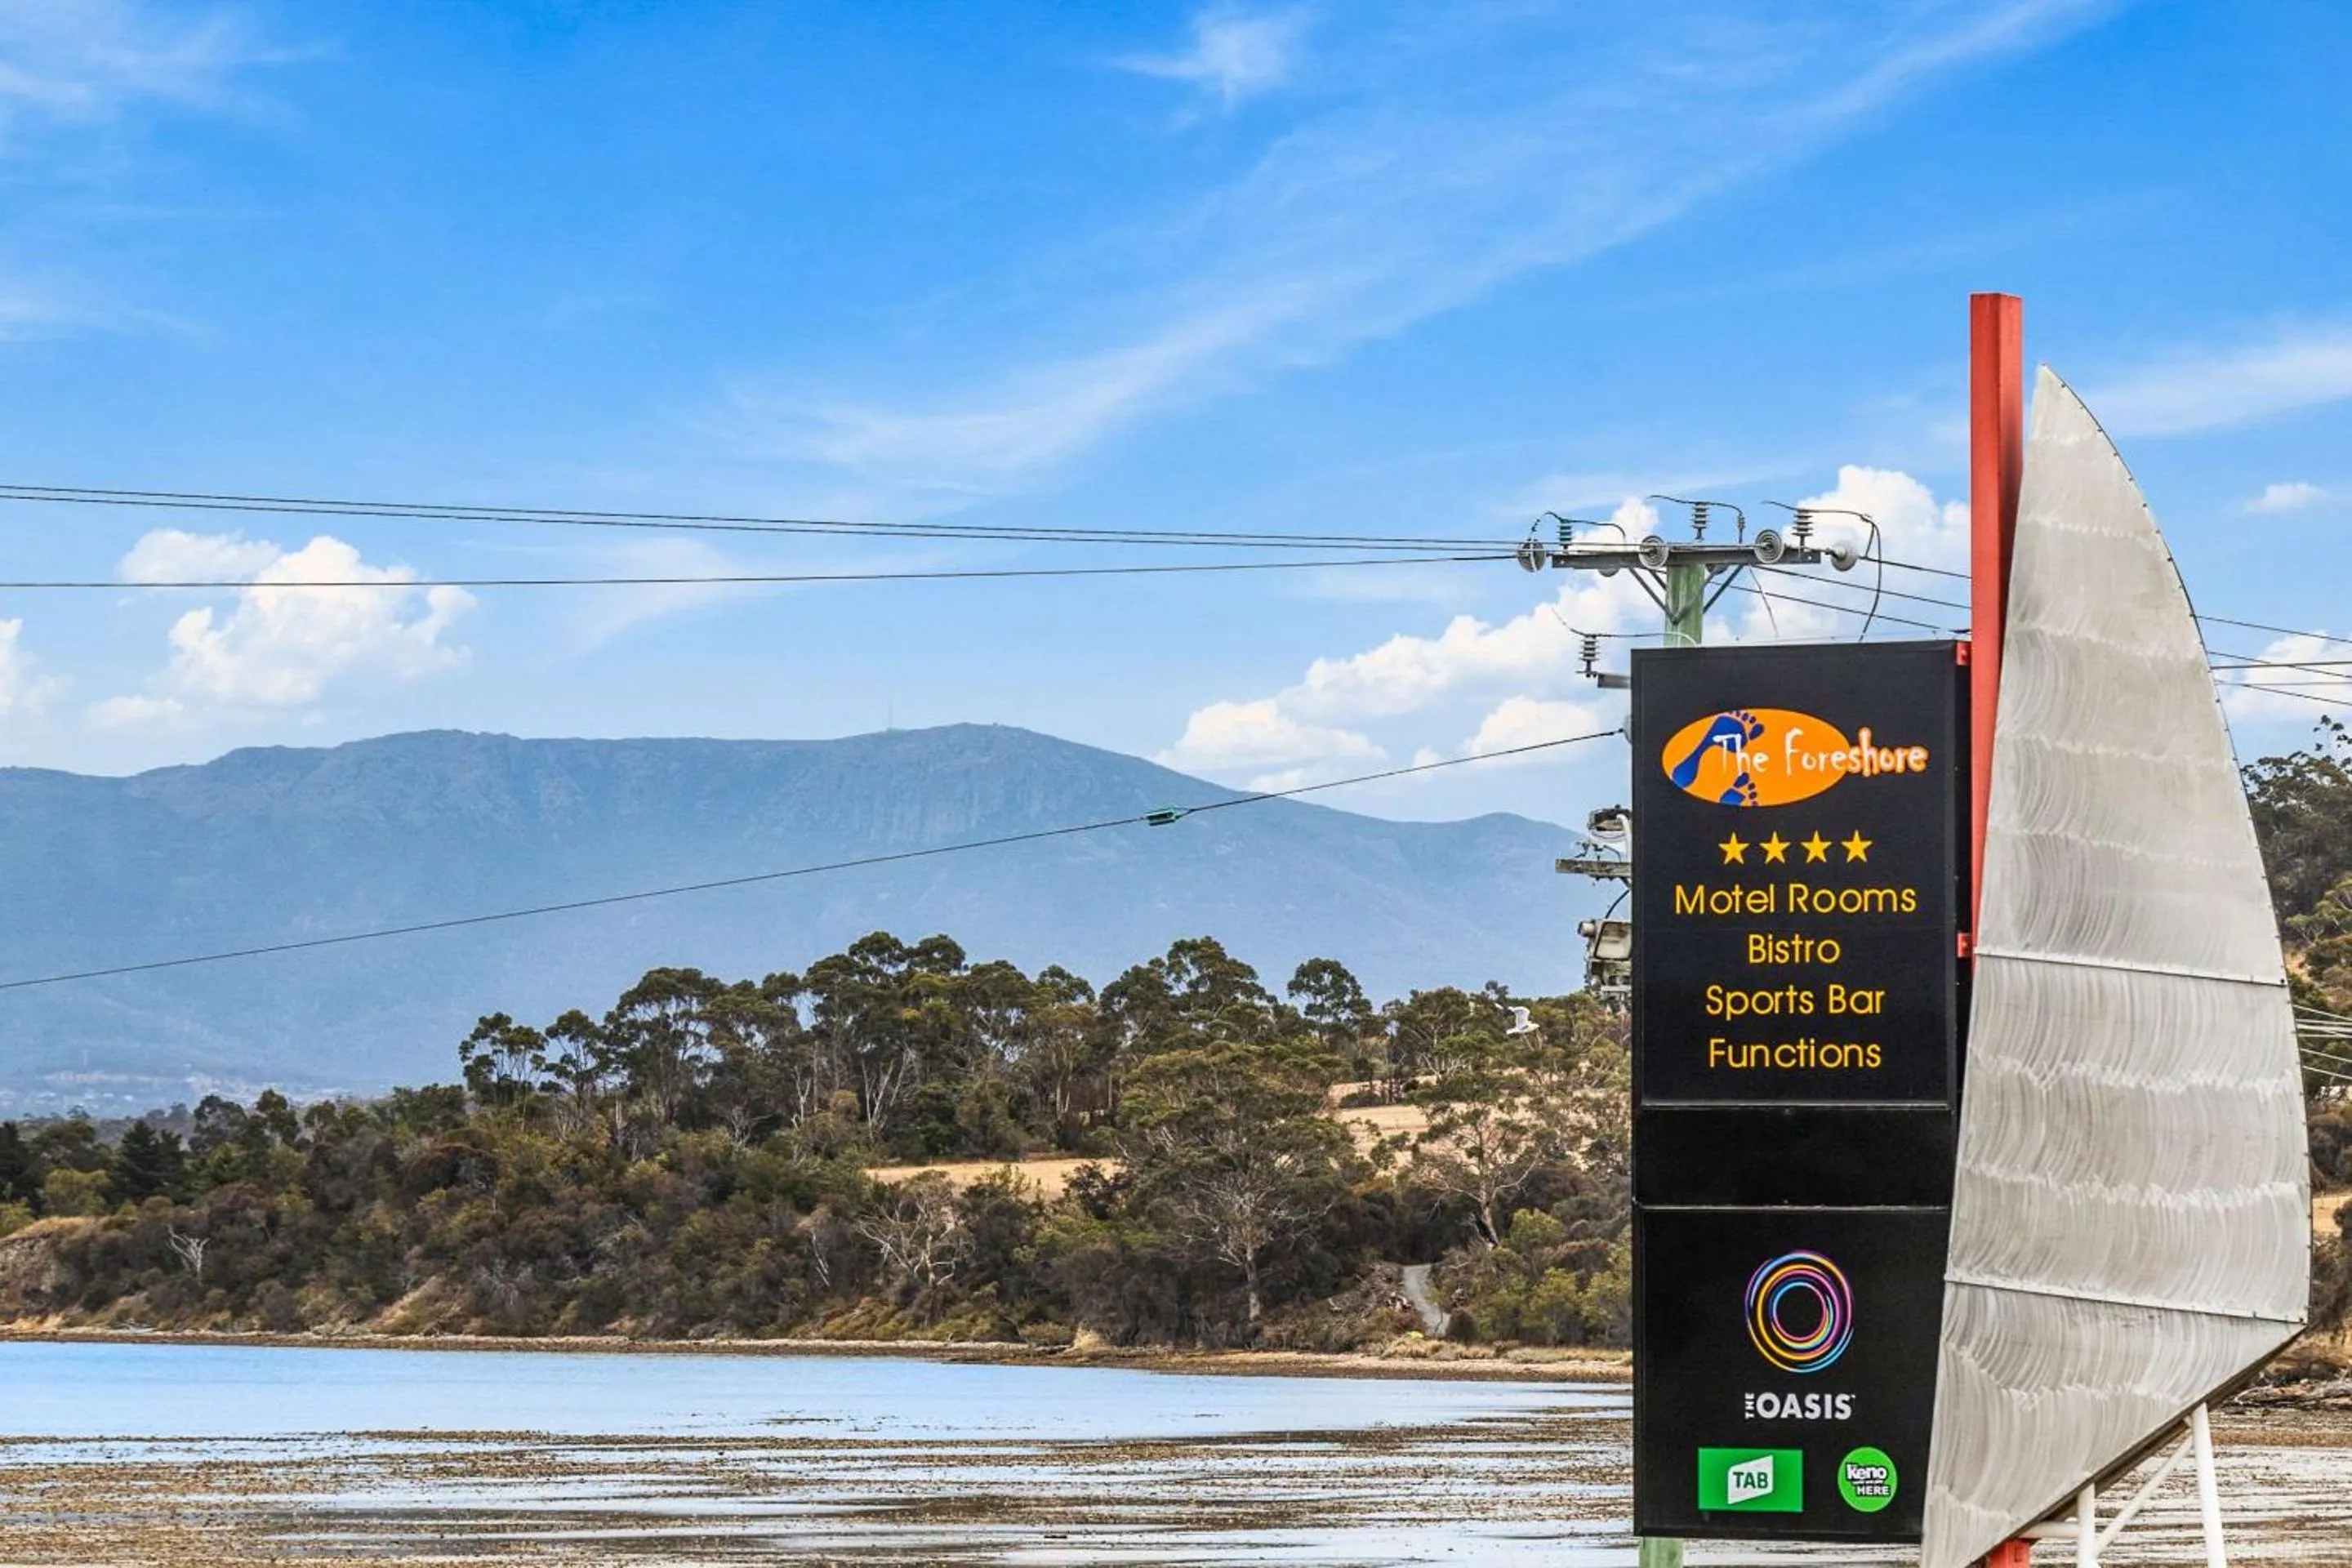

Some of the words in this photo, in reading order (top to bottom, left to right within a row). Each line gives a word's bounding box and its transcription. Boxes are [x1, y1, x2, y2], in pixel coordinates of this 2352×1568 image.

[1713, 733, 1769, 775] The
[1785, 727, 1928, 777] Foreshore
[1675, 884, 1775, 914] Motel
[1788, 884, 1916, 912] Rooms
[1748, 934, 1841, 964] Bistro
[1706, 984, 1814, 1020] Sports
[1829, 984, 1885, 1013] Bar
[1709, 1038, 1882, 1068] Functions
[1744, 1392, 1755, 1419] THE
[1756, 1392, 1852, 1419] OASIS
[1733, 1472, 1768, 1490] TAB
[1856, 1485, 1891, 1496] HERE
